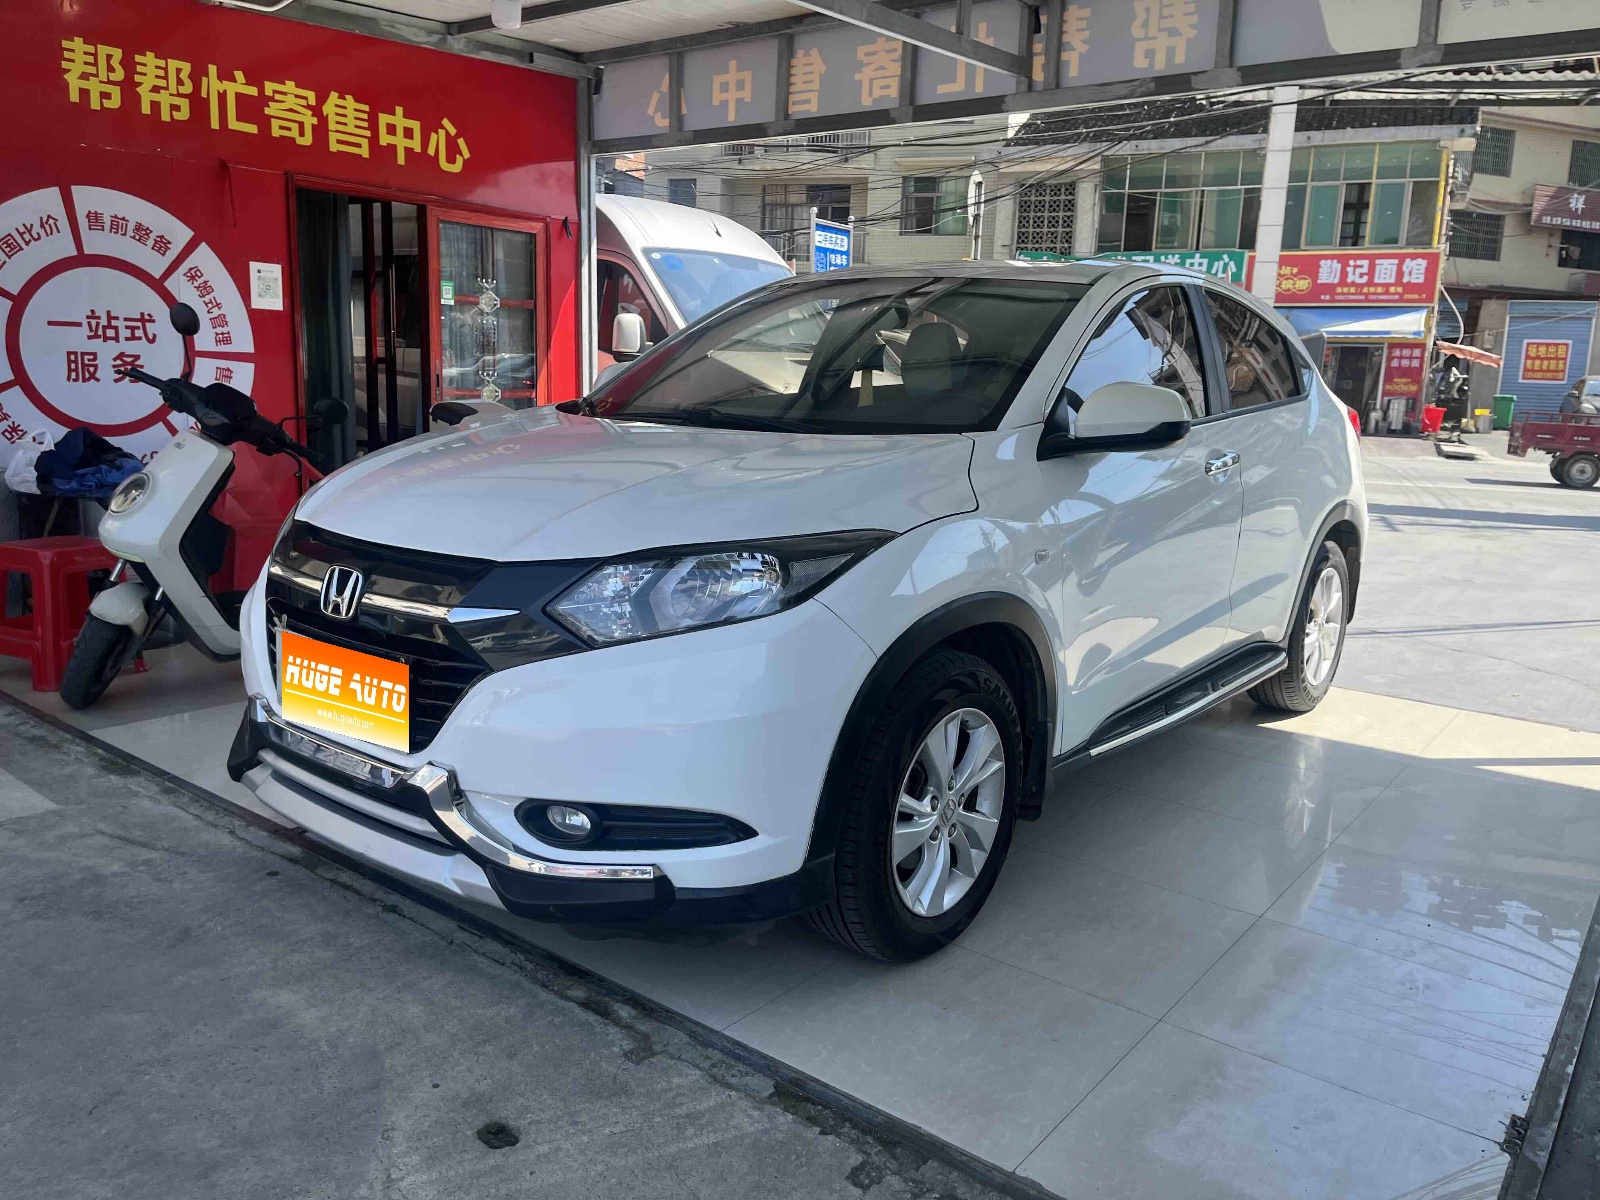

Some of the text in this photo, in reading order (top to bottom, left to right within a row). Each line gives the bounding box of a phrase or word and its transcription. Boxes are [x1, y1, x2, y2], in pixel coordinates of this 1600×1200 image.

[61, 36, 471, 174] 帮帮忙寄售中心
[1569, 193, 1586, 215] 祥
[0, 214, 60, 273] 国比价
[85, 209, 173, 257] 售前整备
[1317, 258, 1427, 284] 勤记面馆
[182, 265, 233, 346] 保姆式管理
[47, 309, 157, 344] 一站式
[66, 351, 145, 384] 服务
[1527, 344, 1567, 358] 场地出租
